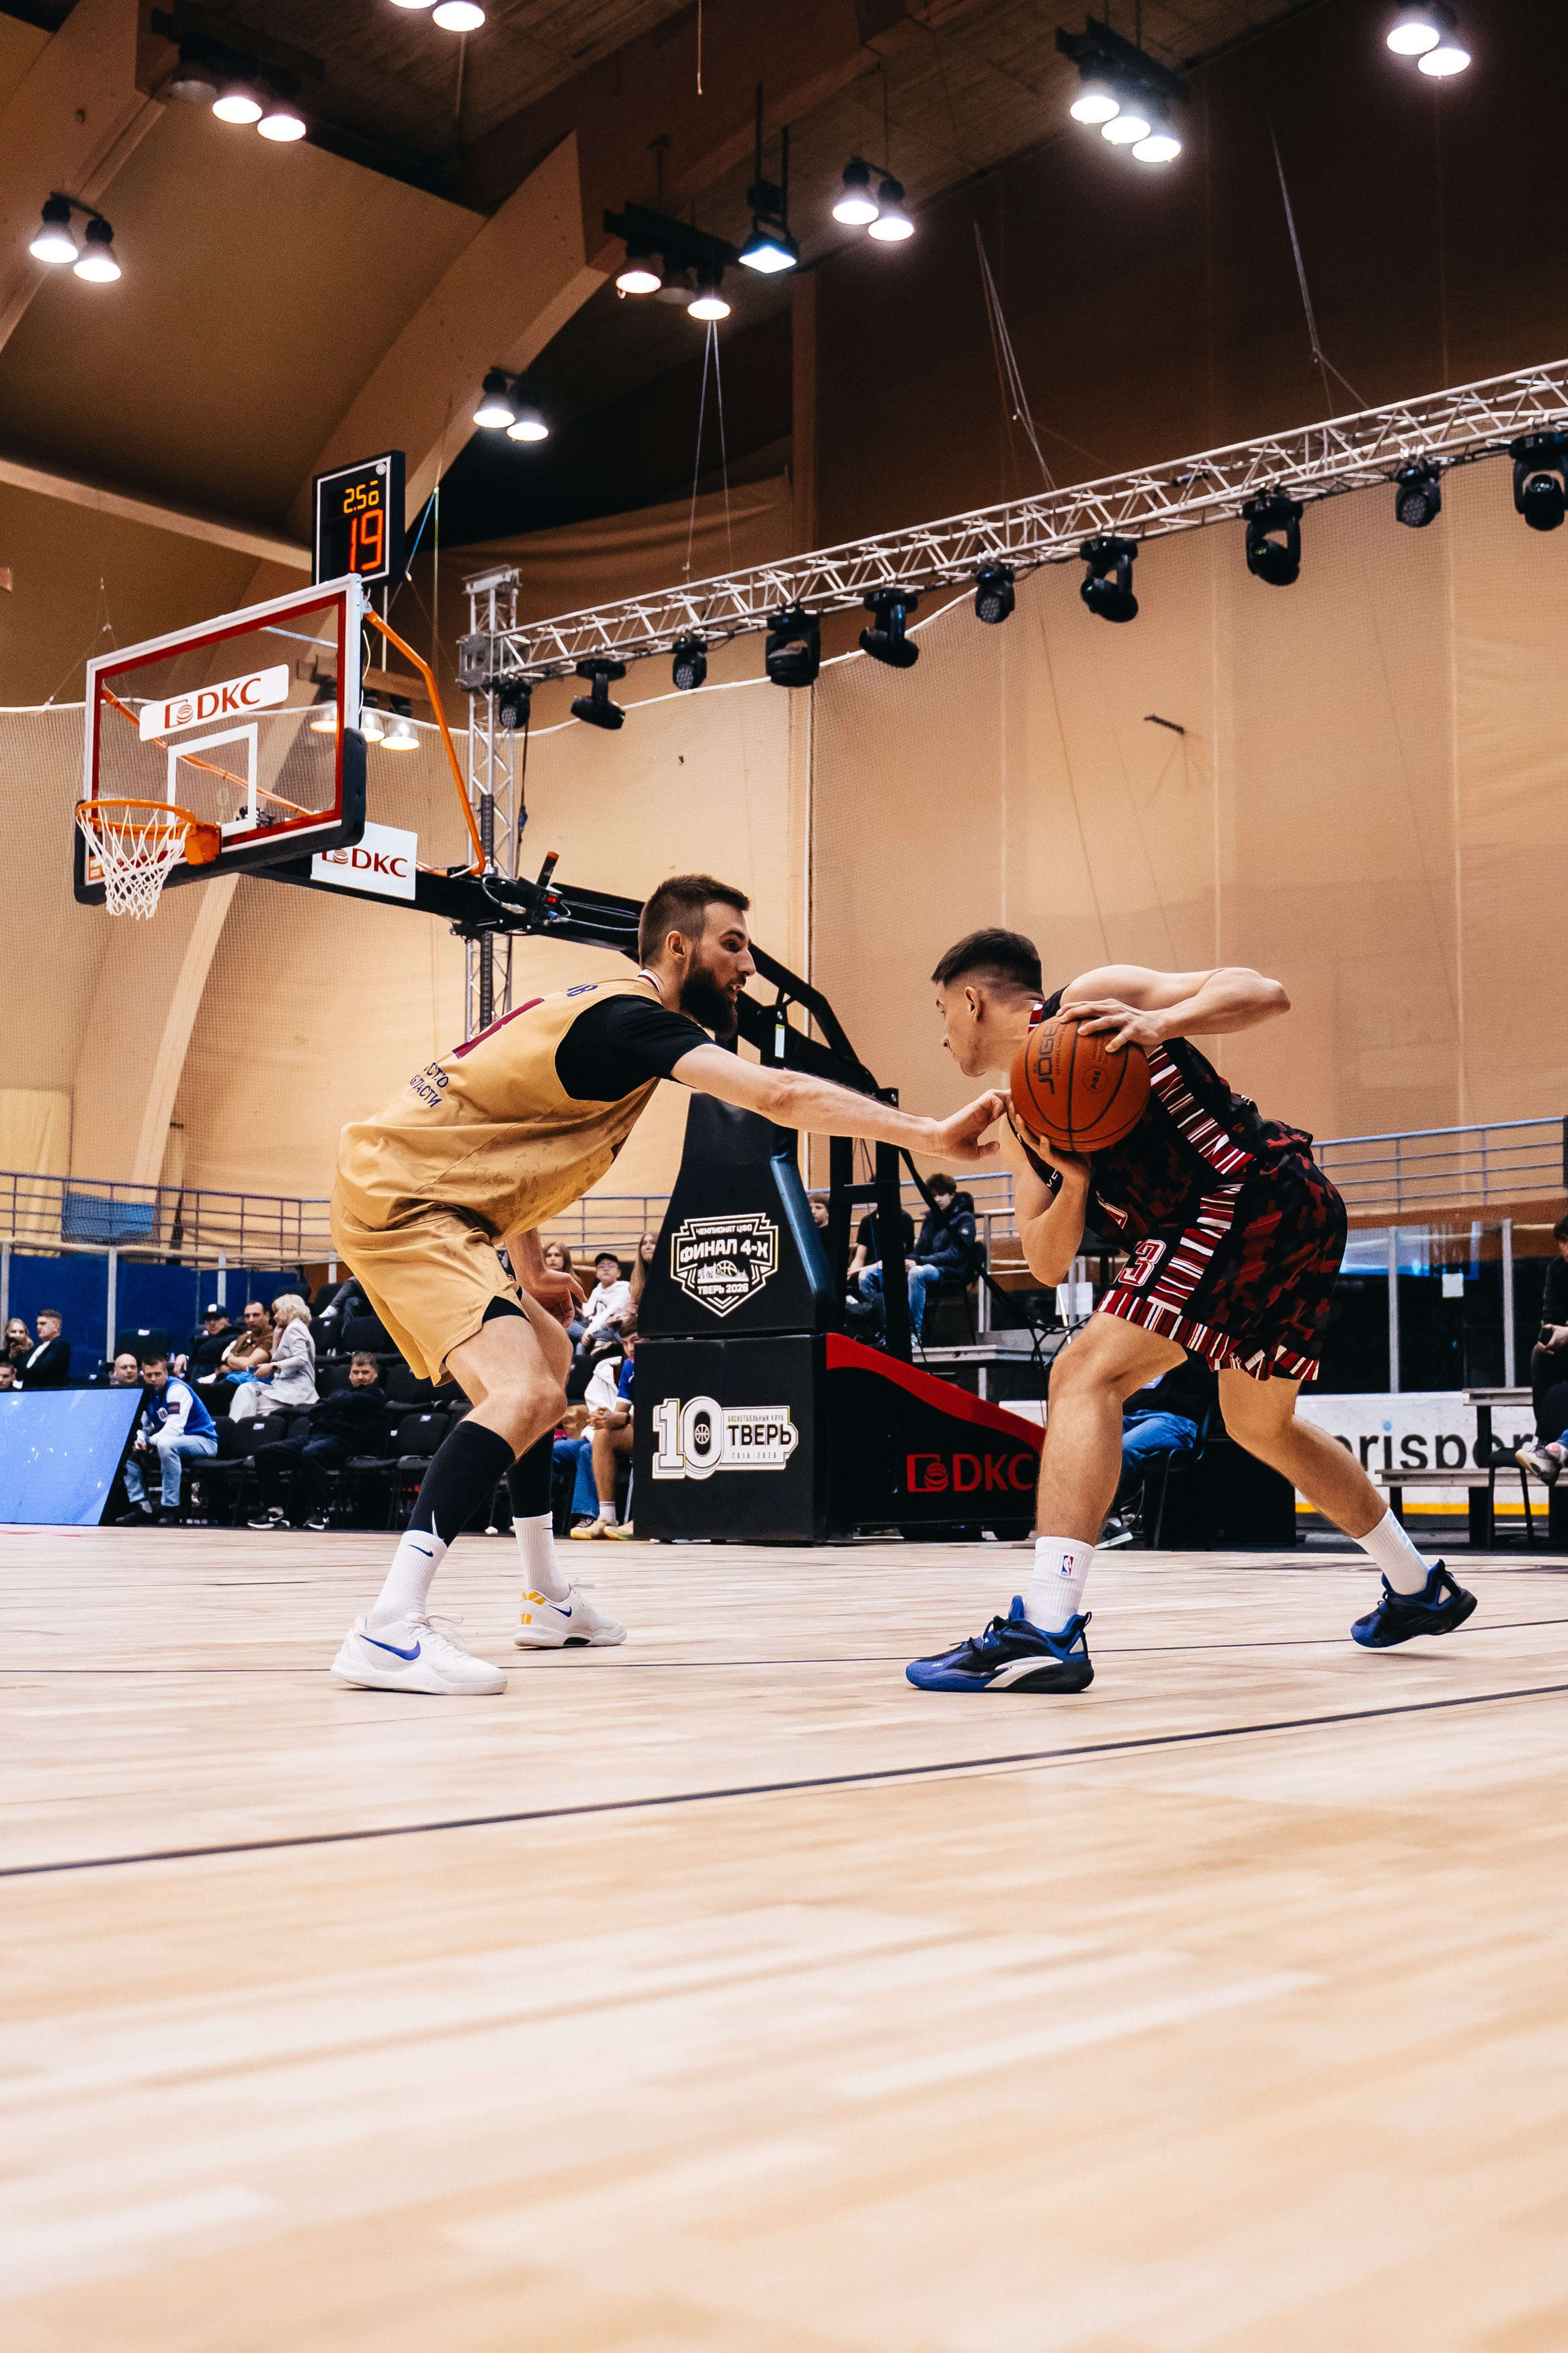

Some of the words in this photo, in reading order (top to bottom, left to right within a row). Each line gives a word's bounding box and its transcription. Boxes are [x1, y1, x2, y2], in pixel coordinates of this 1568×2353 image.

[349, 509, 384, 572] 19
[197, 678, 261, 720] DKC
[352, 847, 407, 878] DKC
[679, 1238, 737, 1263] ФИНАЛ
[1111, 1239, 1166, 1286] 3
[697, 1285, 725, 1295] ТВЕРЬ
[653, 1396, 724, 1479] 10
[727, 1423, 792, 1446] ТВЕРЬ
[952, 1453, 1034, 1492] DKC
